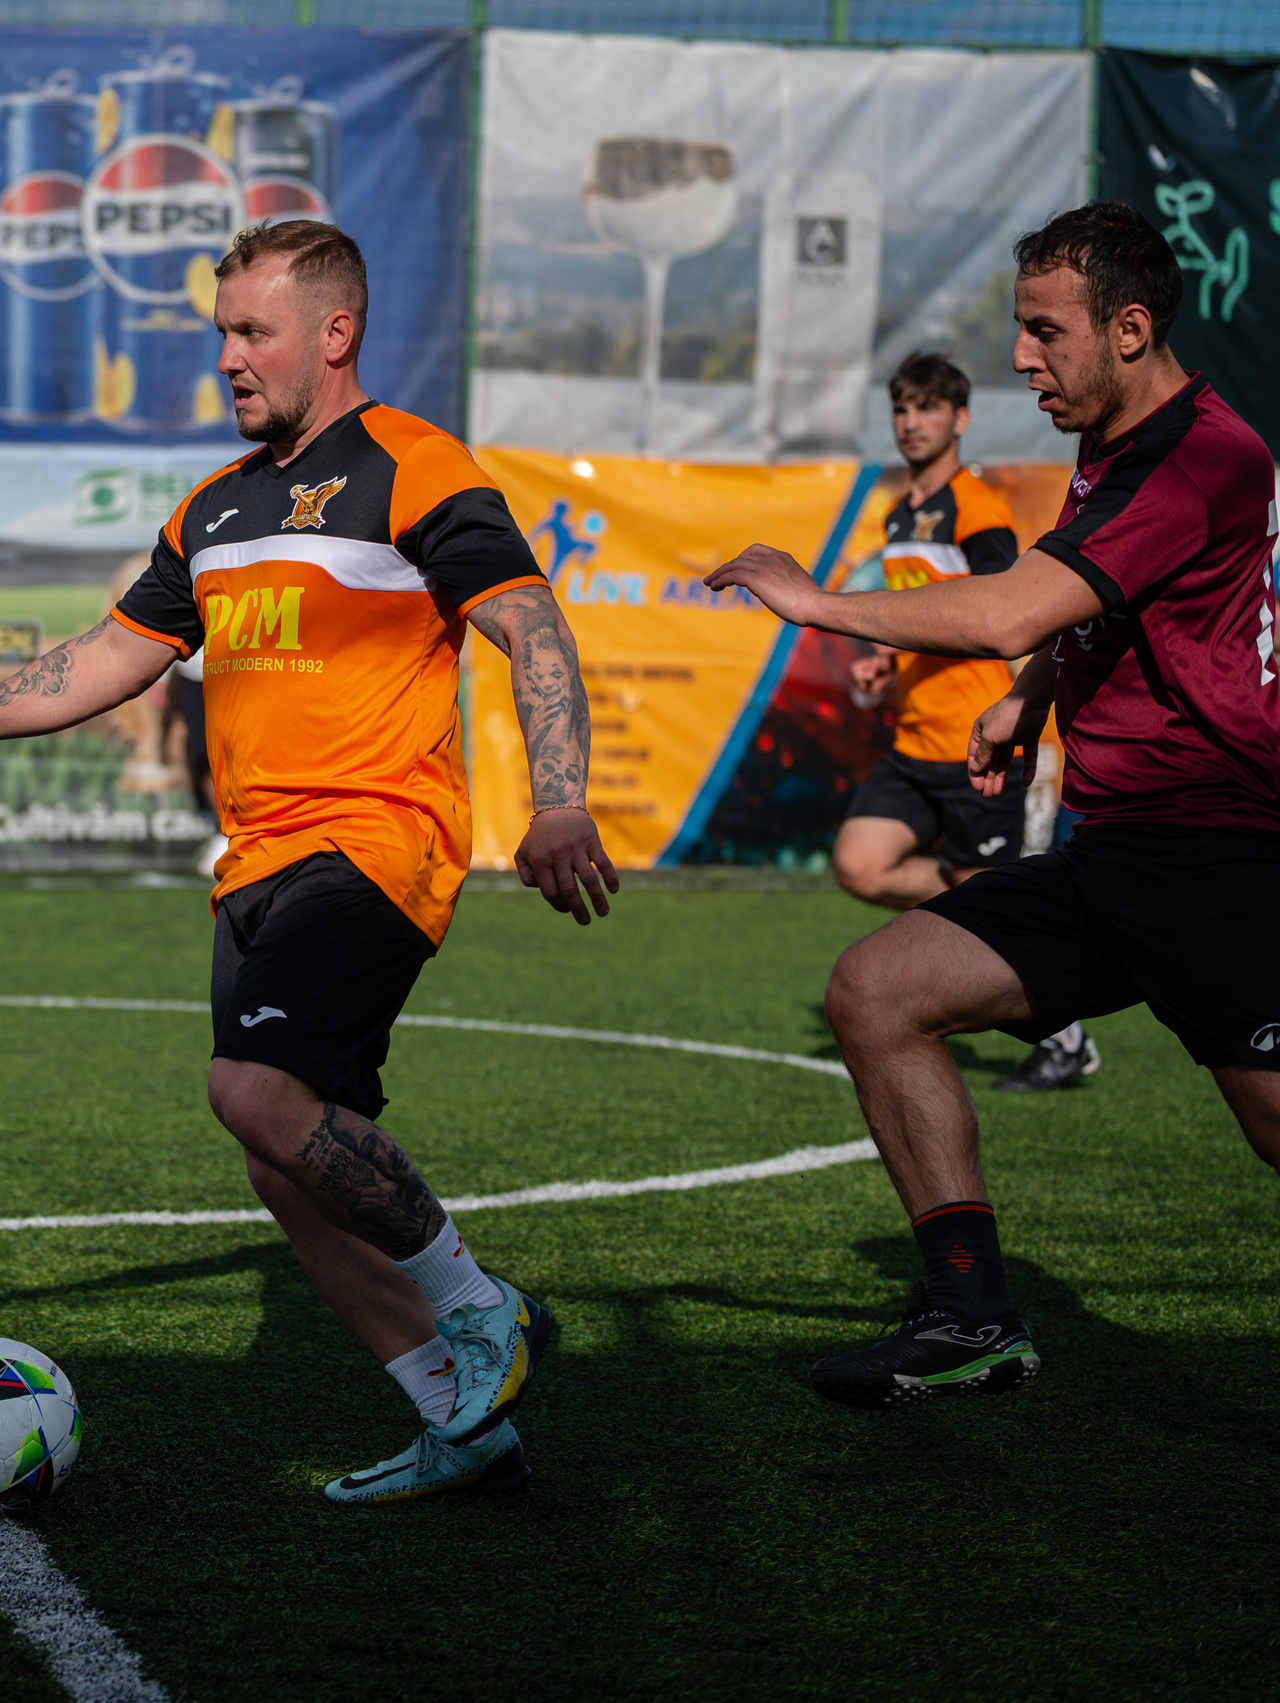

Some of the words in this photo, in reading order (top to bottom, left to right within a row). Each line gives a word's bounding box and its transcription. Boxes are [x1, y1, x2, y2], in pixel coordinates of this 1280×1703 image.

[95, 202, 233, 235] PEPSI
[567, 571, 647, 606] LIVE
[203, 586, 306, 657] PCM
[231, 657, 284, 673] MODERN
[289, 658, 324, 674] 1992
